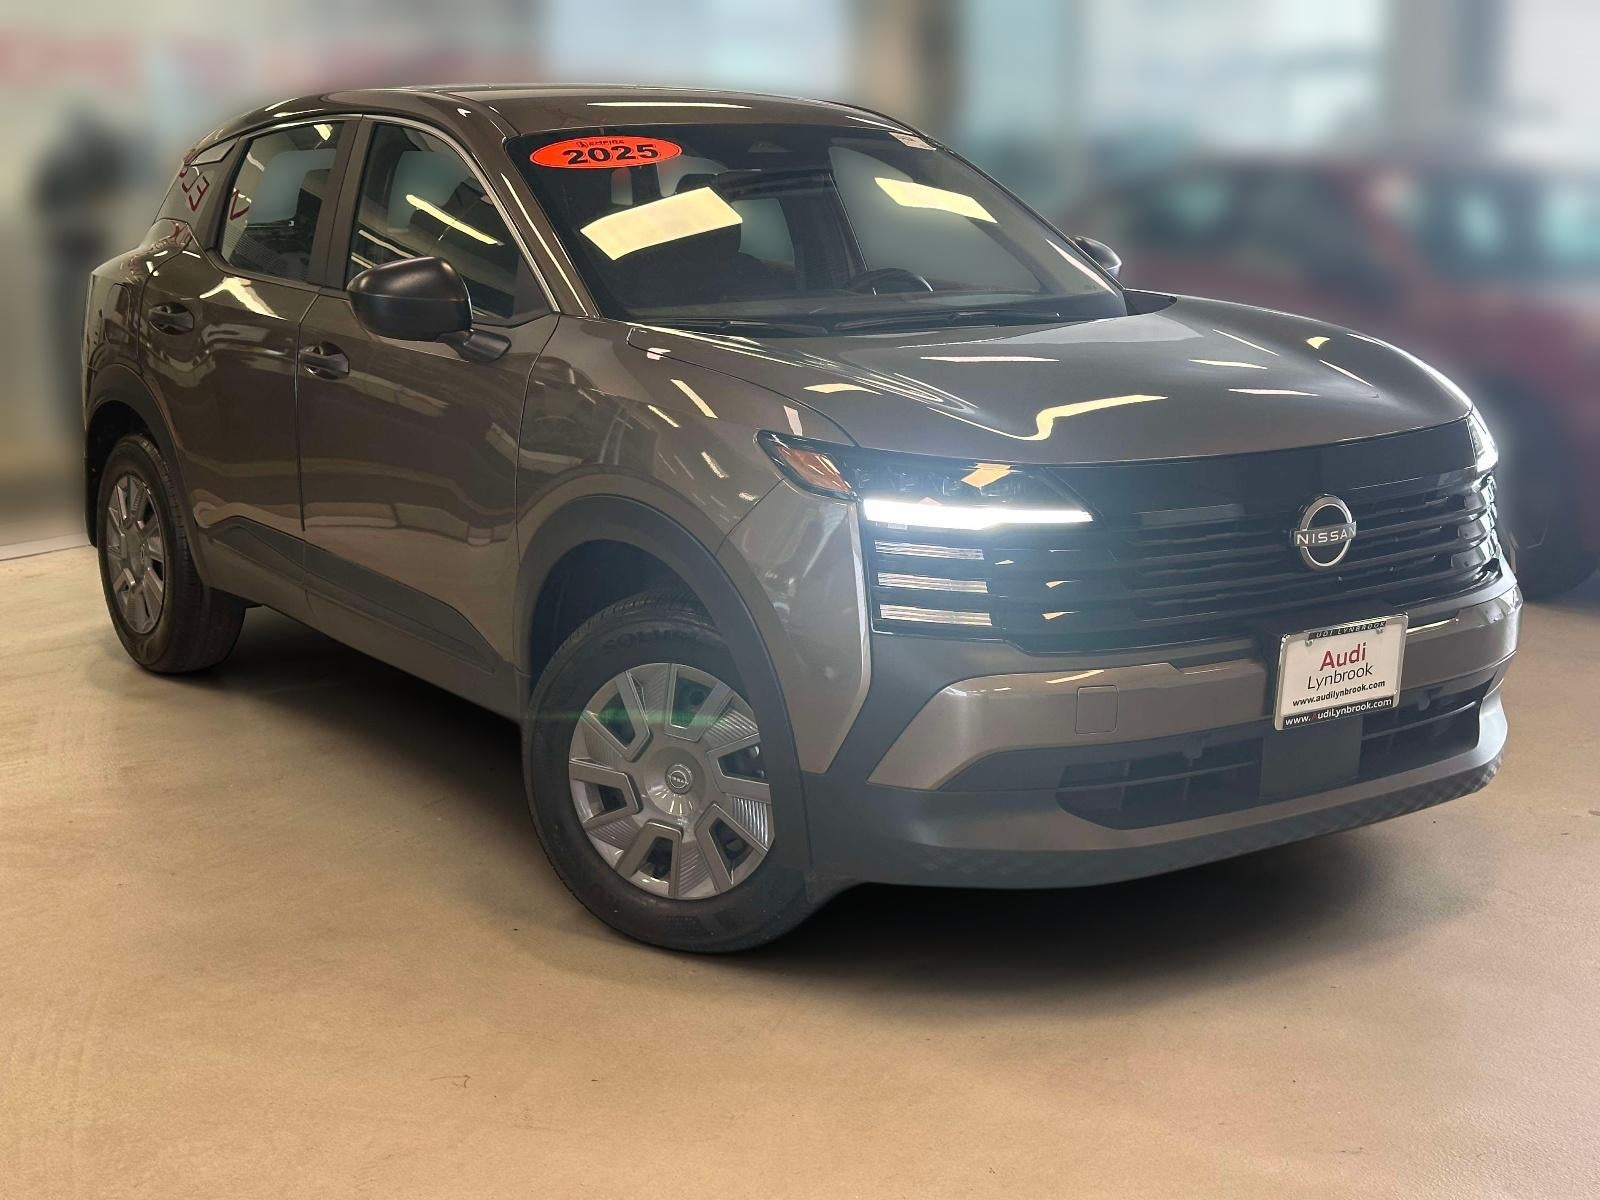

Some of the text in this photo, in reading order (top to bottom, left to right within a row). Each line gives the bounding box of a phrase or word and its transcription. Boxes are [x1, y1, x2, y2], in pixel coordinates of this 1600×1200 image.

[562, 144, 660, 165] 2025
[1296, 526, 1357, 545] NISSAN
[1337, 621, 1386, 635] LYNBROOK
[1320, 642, 1367, 671] Audi
[1307, 662, 1374, 691] Lynbrook
[1292, 680, 1386, 706] www.audilynbrook.com
